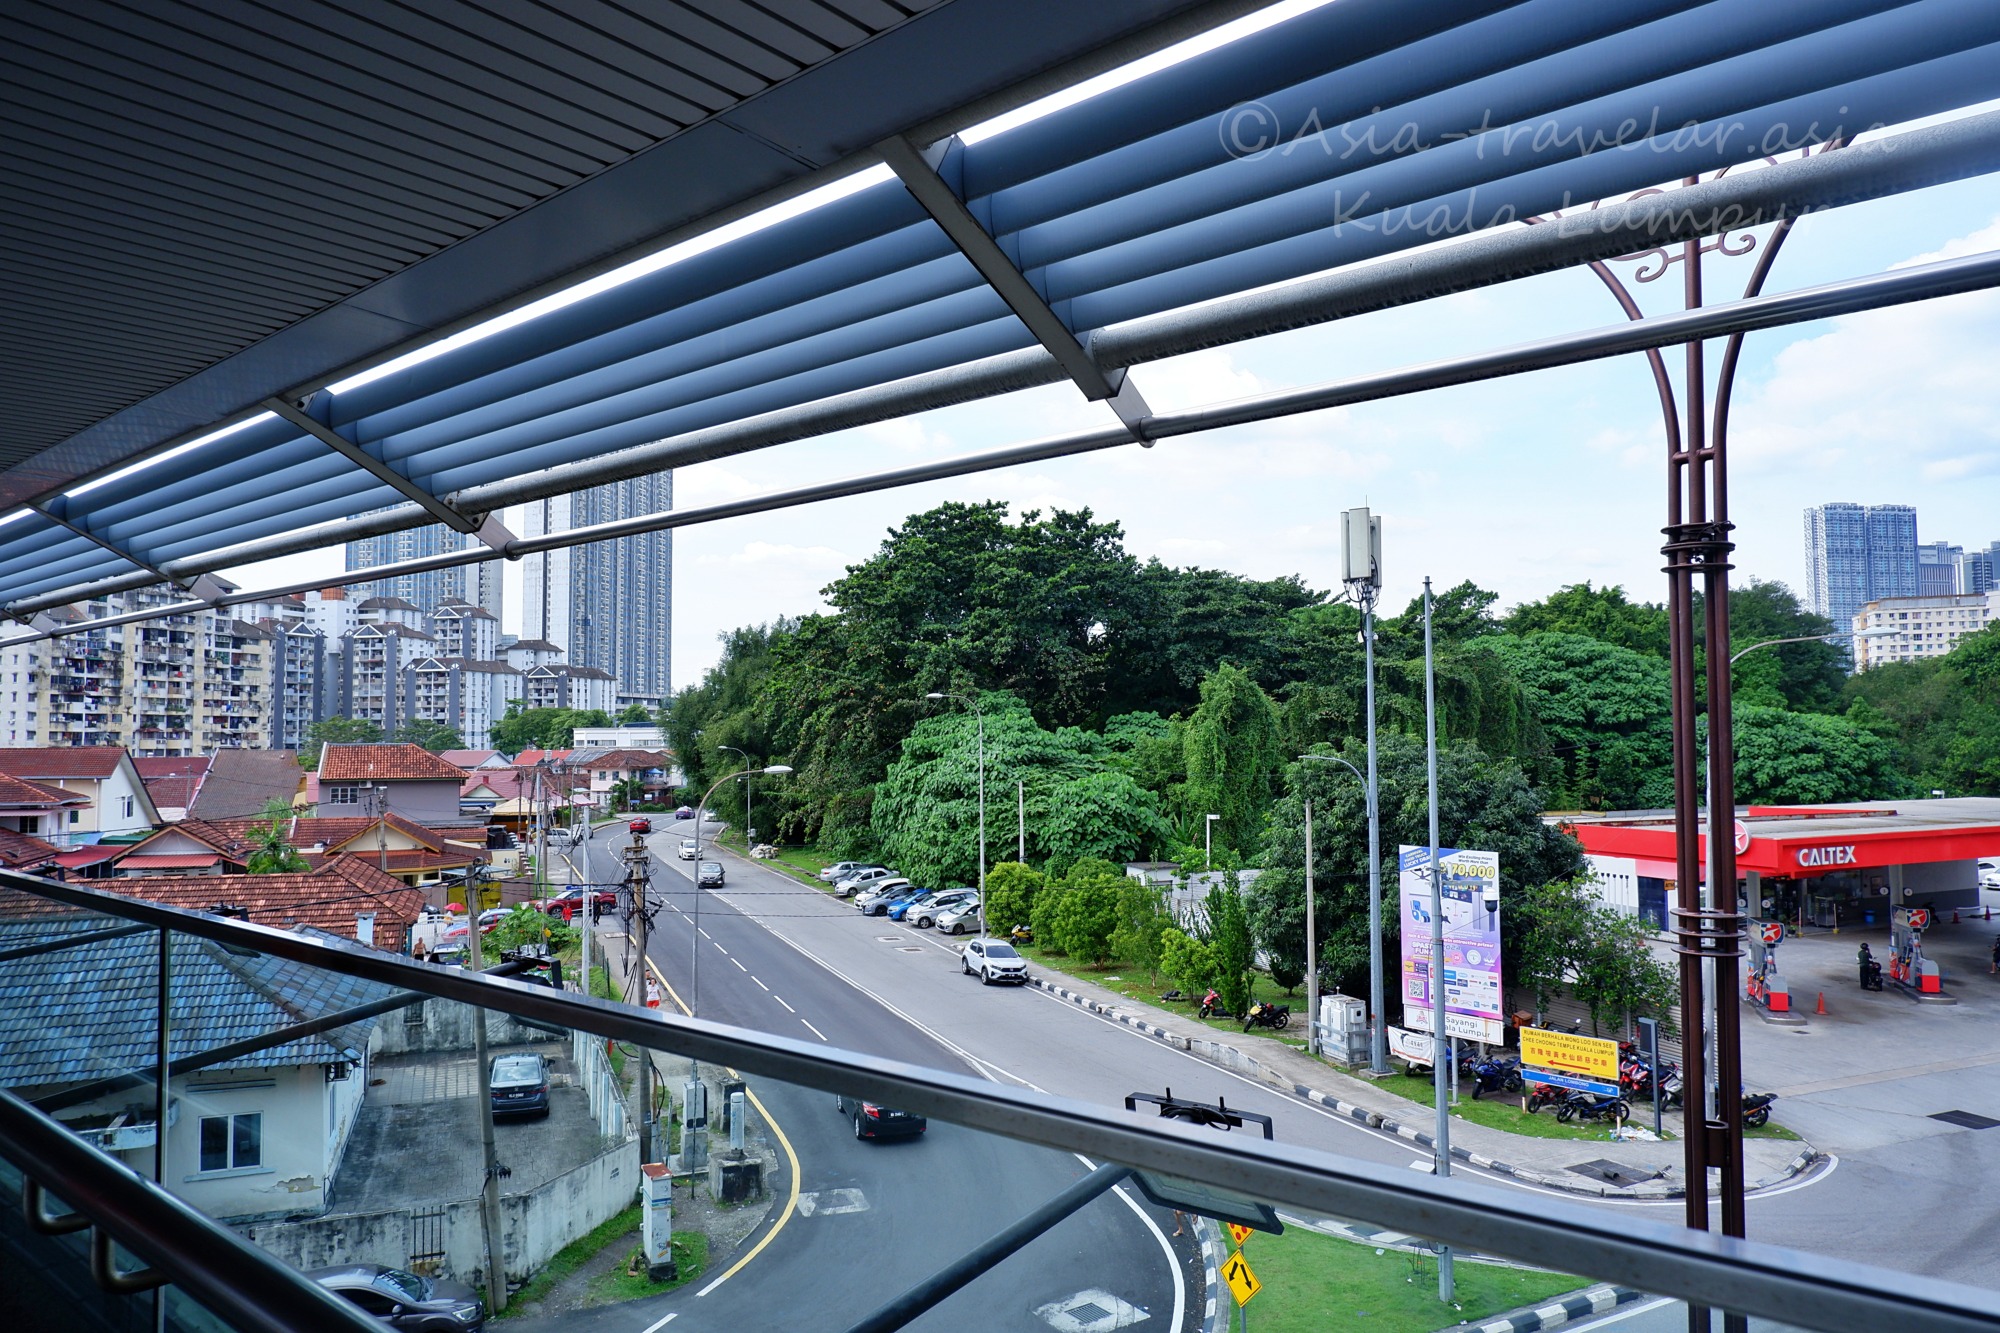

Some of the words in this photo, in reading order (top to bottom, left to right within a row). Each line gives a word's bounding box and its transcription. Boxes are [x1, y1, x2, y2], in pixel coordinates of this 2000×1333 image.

[1403, 859, 1419, 868] LUCKY
[1799, 845, 1857, 867] CALTEX
[1446, 1016, 1478, 1029] Sayangi
[1458, 1025, 1491, 1038] Lumpur
[1523, 1029, 1541, 1037] RUMAH
[1541, 1031, 1564, 1041] BERHALA
[1564, 1035, 1579, 1044] WONG
[1581, 1038, 1591, 1046] LOO
[1535, 1038, 1556, 1047] CHOONG
[1557, 1041, 1575, 1050] TEMPLE
[1593, 1048, 1615, 1056] LUMPUR
